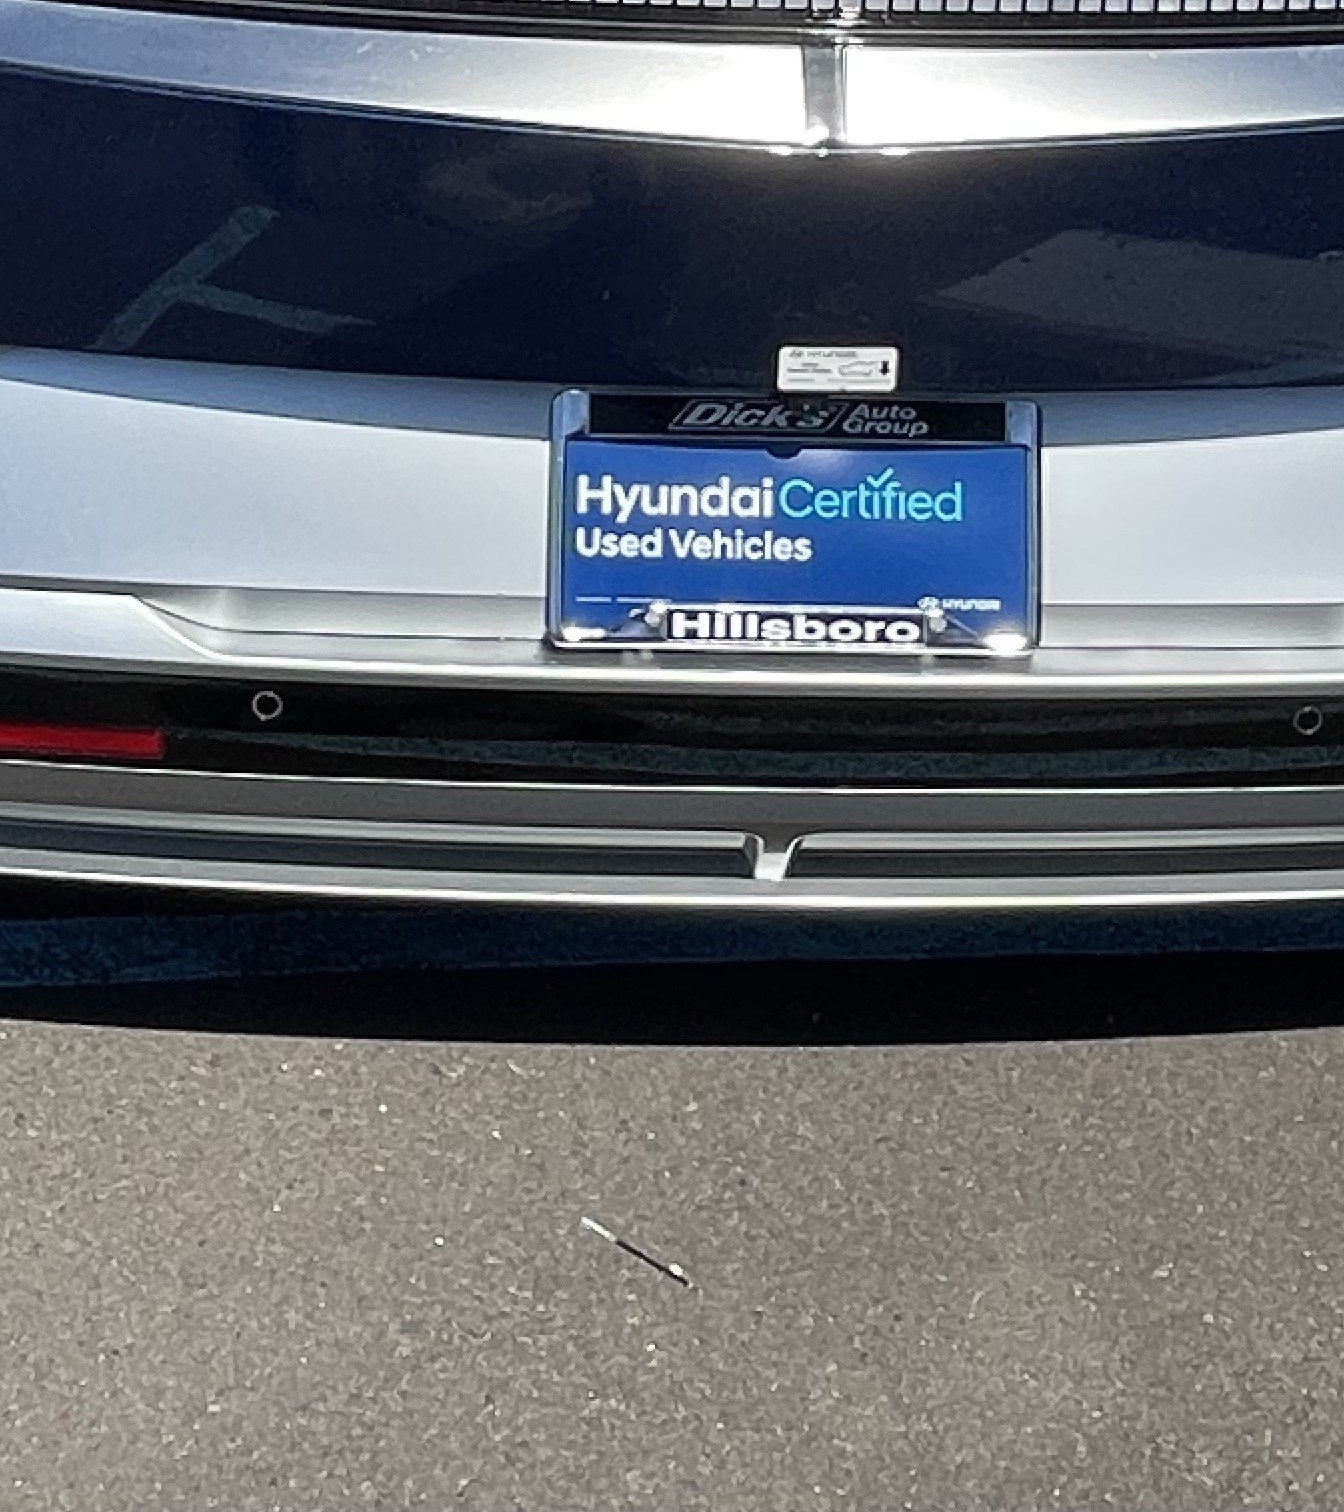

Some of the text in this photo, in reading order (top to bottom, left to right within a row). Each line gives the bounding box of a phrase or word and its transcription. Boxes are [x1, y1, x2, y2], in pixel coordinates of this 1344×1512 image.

[842, 418, 930, 437] Group
[850, 403, 917, 420] Auto
[575, 467, 964, 524] Hyundai Certified
[574, 526, 814, 562] Used Vehicles
[670, 609, 922, 643] Hillsboro
